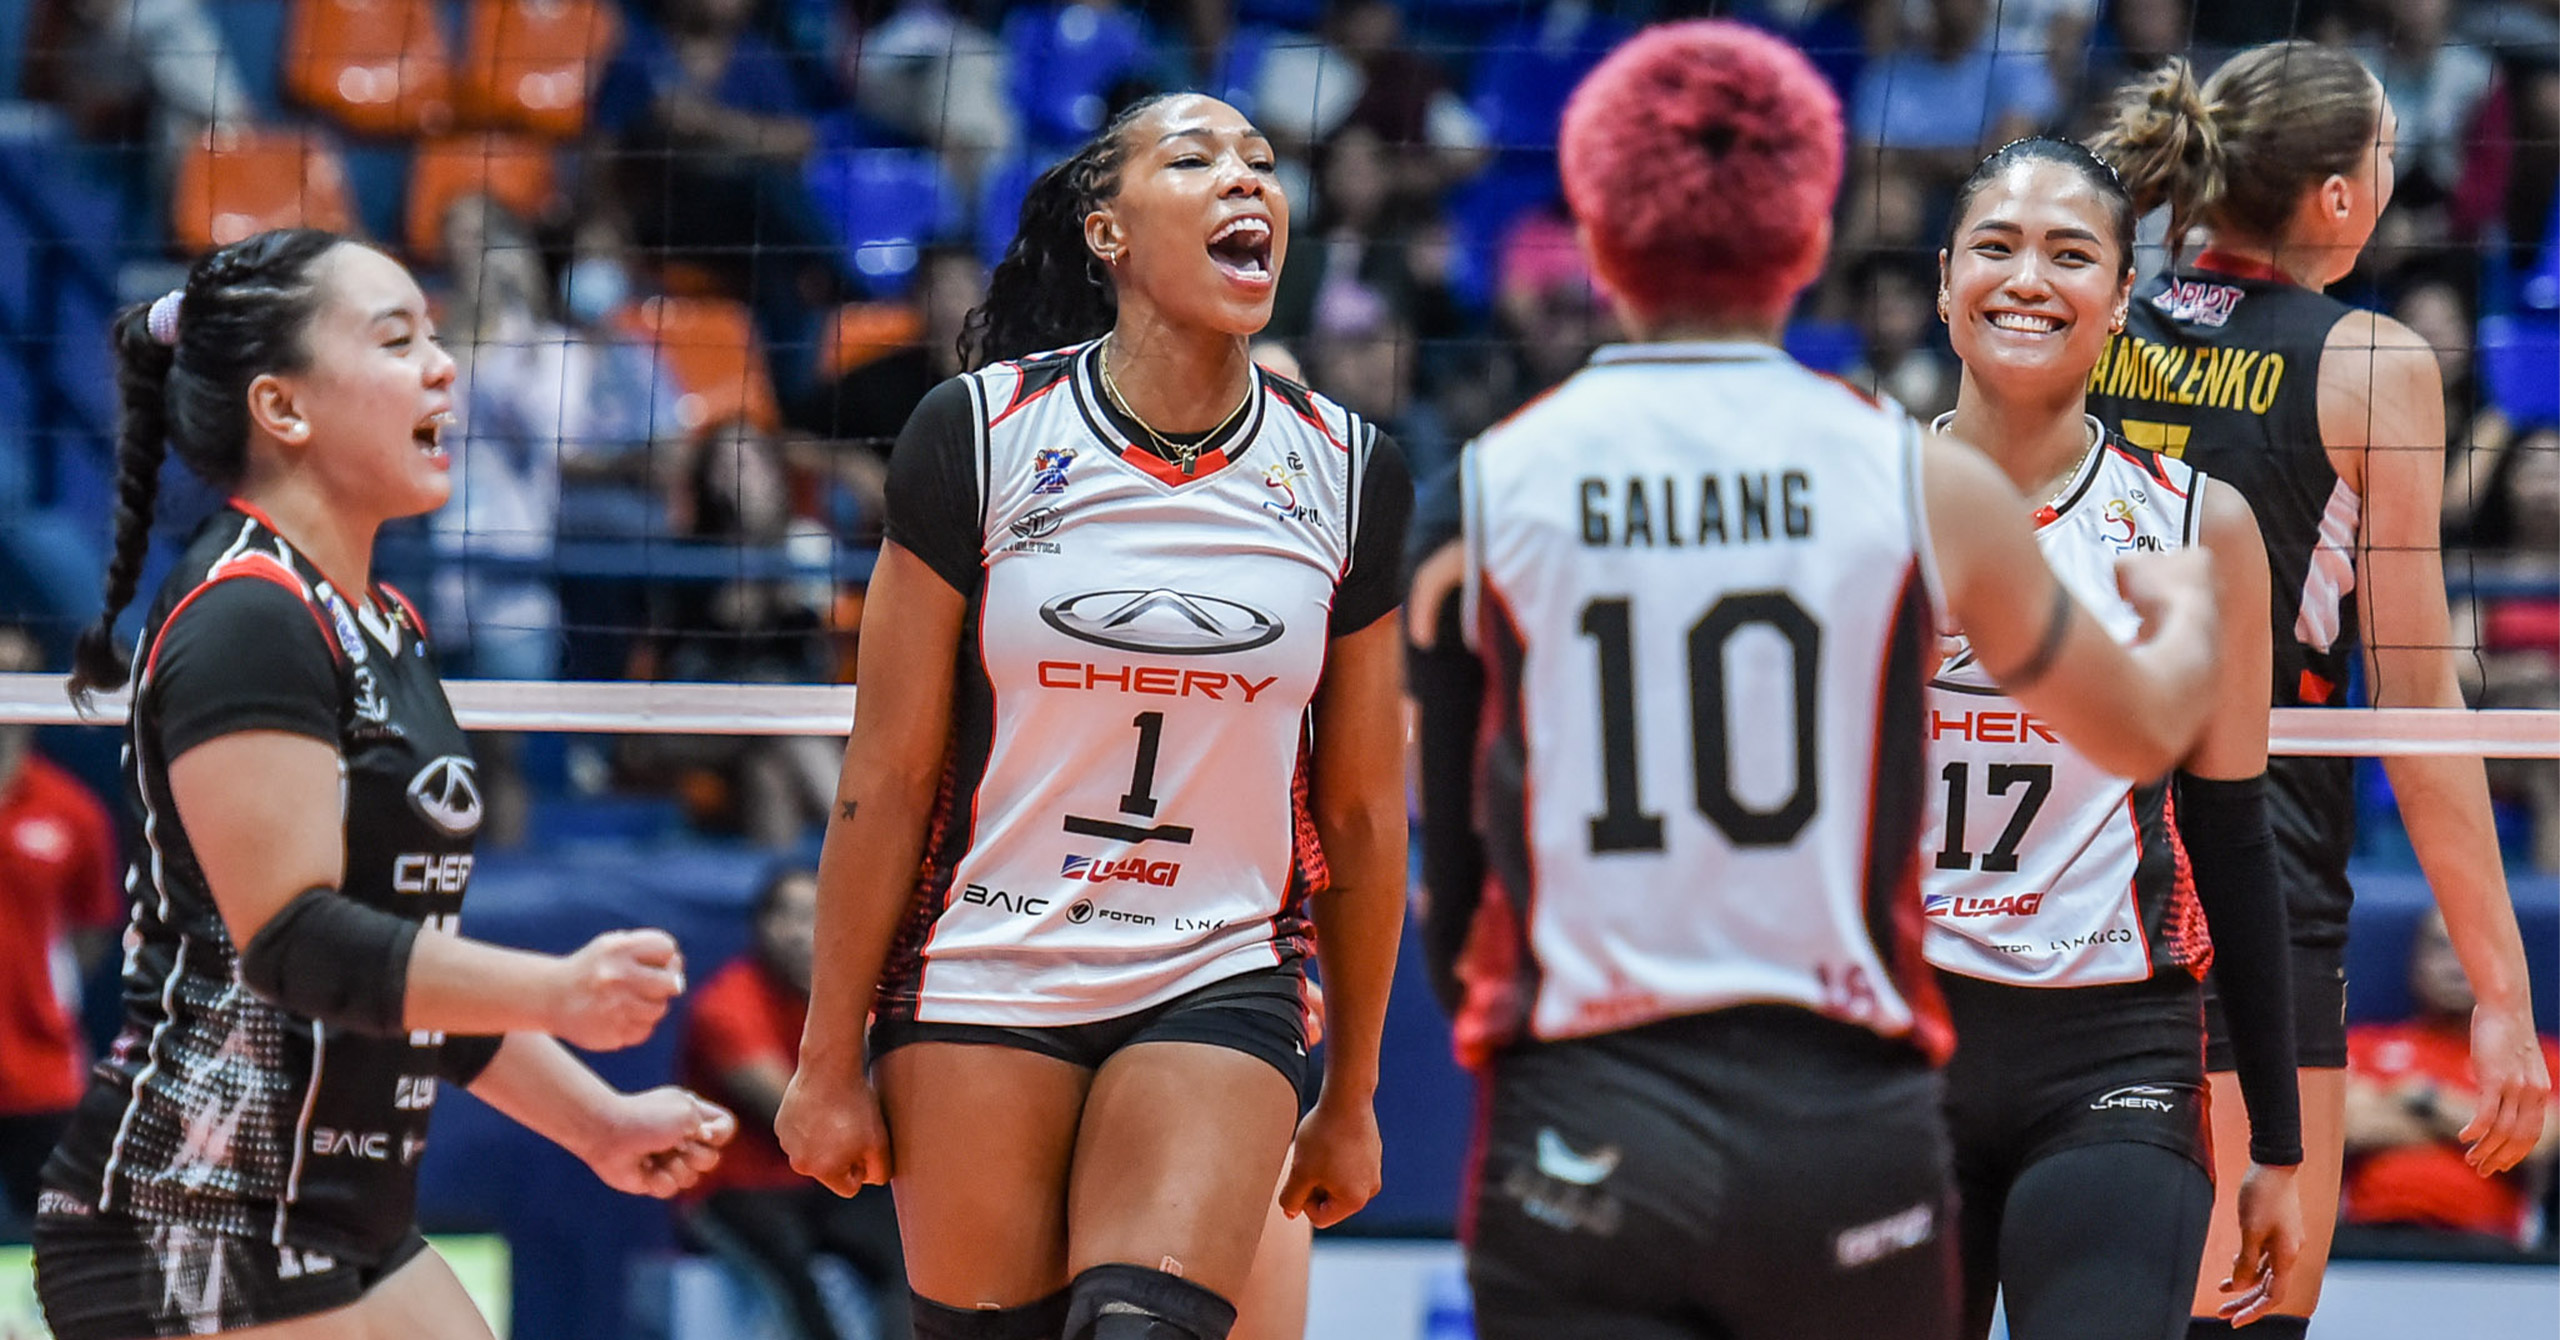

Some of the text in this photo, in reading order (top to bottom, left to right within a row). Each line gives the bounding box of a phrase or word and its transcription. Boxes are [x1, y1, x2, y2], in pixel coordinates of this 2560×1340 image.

[2088, 334, 2285, 416] AMOILENKO
[1577, 470, 1813, 548] GALANG
[1001, 541, 1062, 554] HLETICA
[1038, 660, 1279, 703] CHERY
[1577, 587, 1823, 855] 10
[1923, 711, 2061, 744] HER
[1118, 711, 1164, 819] 1
[1935, 761, 2053, 873] 17
[393, 854, 475, 893] CHER
[1086, 858, 1181, 888] UAAGI
[962, 883, 1049, 916] BAIC
[1099, 909, 1156, 926] FOTON
[1991, 944, 2033, 955] TON
[312, 1129, 387, 1160] BAIC
